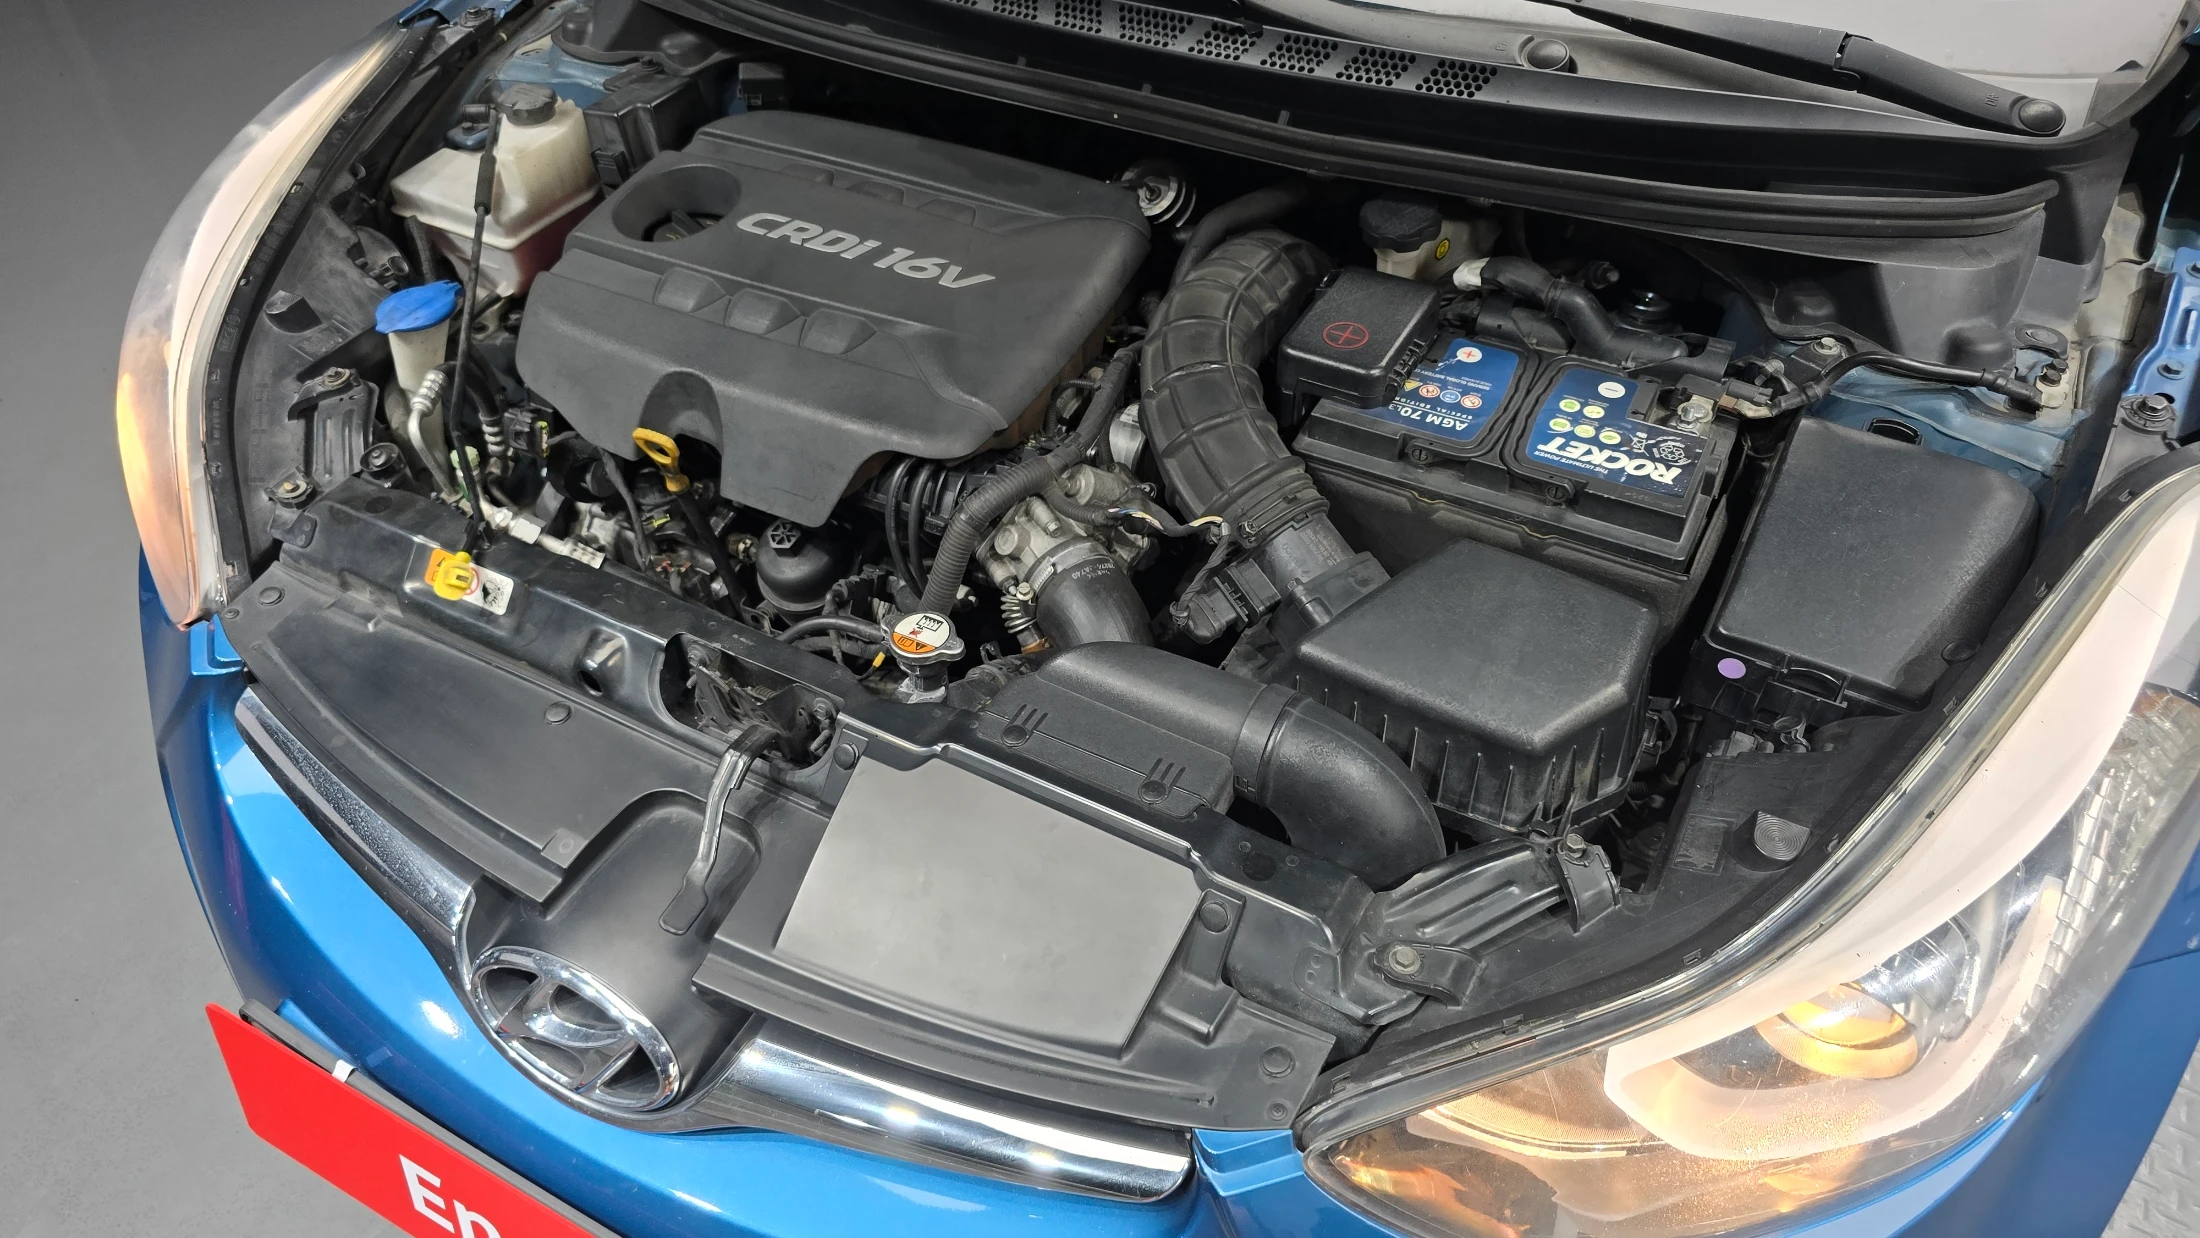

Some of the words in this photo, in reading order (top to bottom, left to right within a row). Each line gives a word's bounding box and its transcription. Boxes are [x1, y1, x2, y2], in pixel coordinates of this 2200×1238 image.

[873, 247, 996, 288] 16V
[1420, 370, 1446, 380] BATTERY
[1446, 375, 1467, 385] GLOBAL
[1394, 396, 1431, 409] EDITION
[1436, 406, 1473, 419] SPECIAL
[1425, 415, 1469, 431] AGM
[1534, 450, 1560, 462] POWER
[1537, 436, 1682, 485] ROCKET
[1560, 456, 1594, 472] ULTIMATE
[1594, 466, 1609, 475] THE
